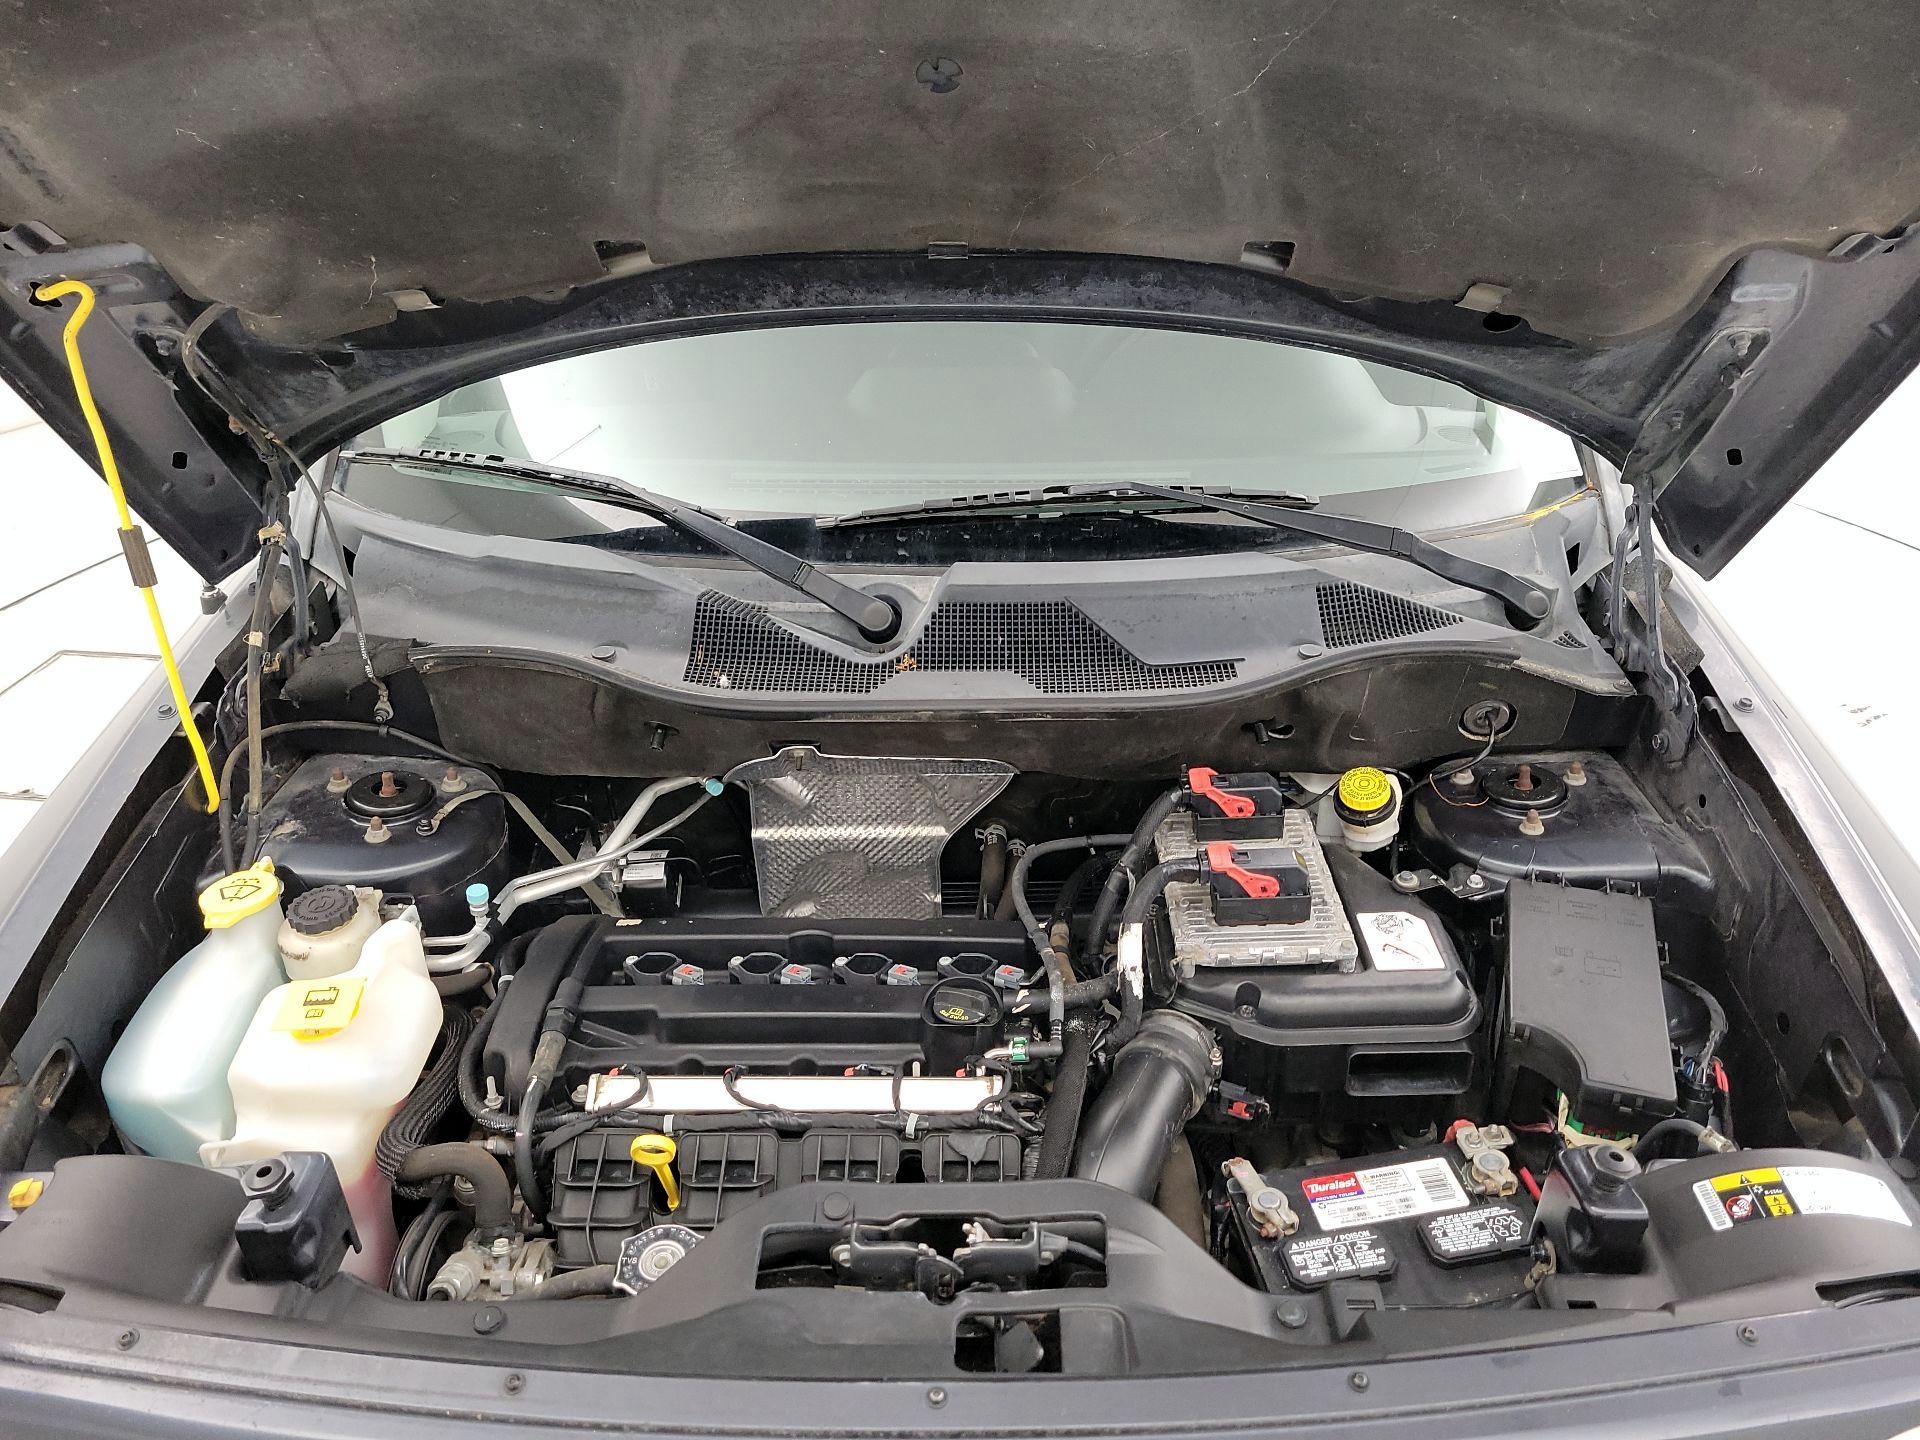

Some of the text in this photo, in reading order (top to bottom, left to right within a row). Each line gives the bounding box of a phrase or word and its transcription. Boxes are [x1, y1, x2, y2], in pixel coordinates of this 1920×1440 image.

[1307, 1177, 1357, 1194] Duralast
[1315, 1194, 1338, 1202] PROVEN
[1299, 1236, 1333, 1248] DANGER
[1340, 1230, 1371, 1242] POISON
